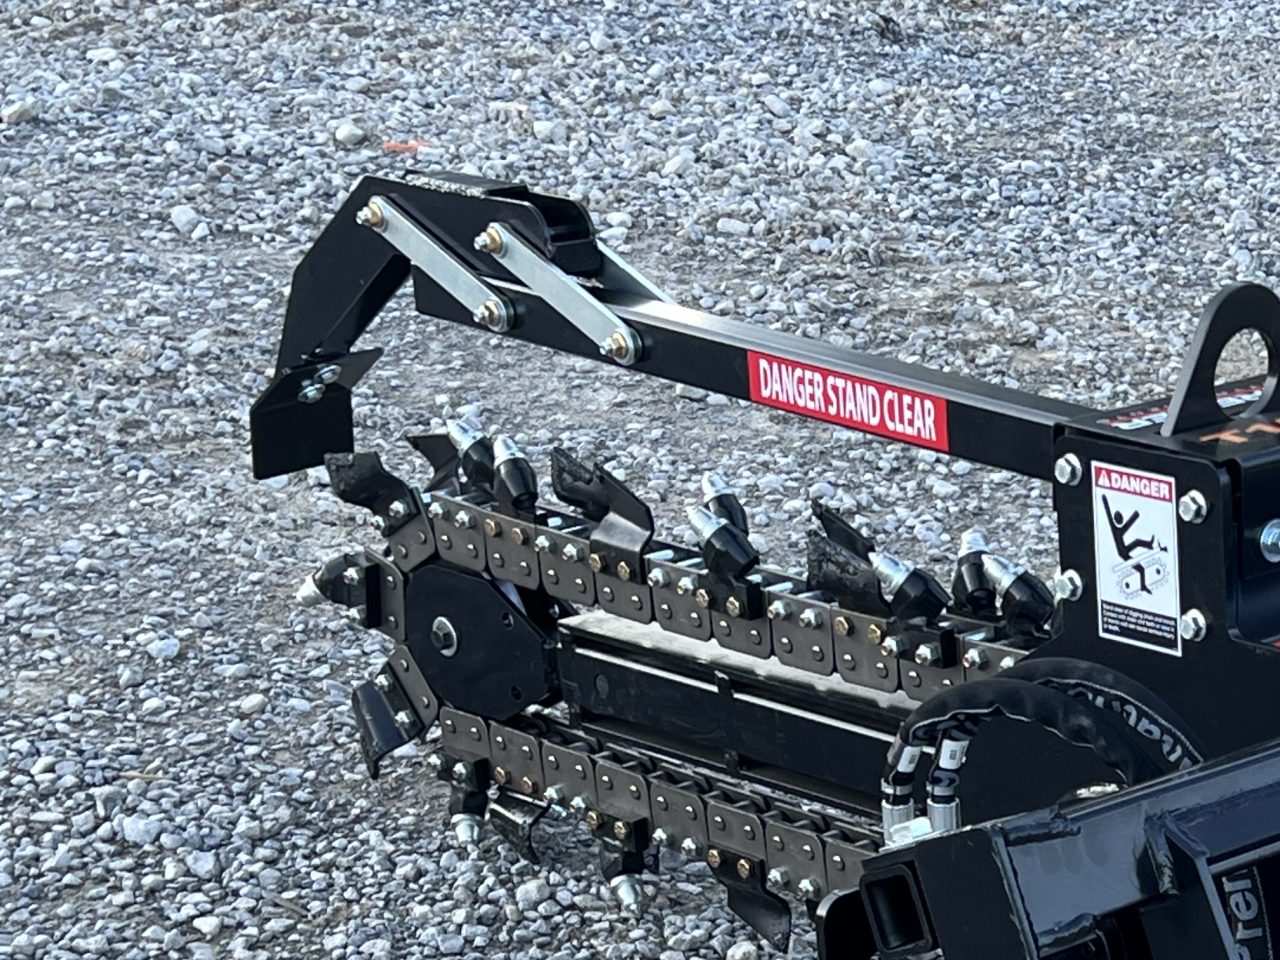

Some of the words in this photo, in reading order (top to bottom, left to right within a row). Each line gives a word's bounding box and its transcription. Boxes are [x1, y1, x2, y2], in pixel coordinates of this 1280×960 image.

[758, 358, 825, 413] DANGER
[826, 375, 881, 427] STAND
[883, 389, 937, 442] CLEAR
[1110, 473, 1171, 500] DANGER
